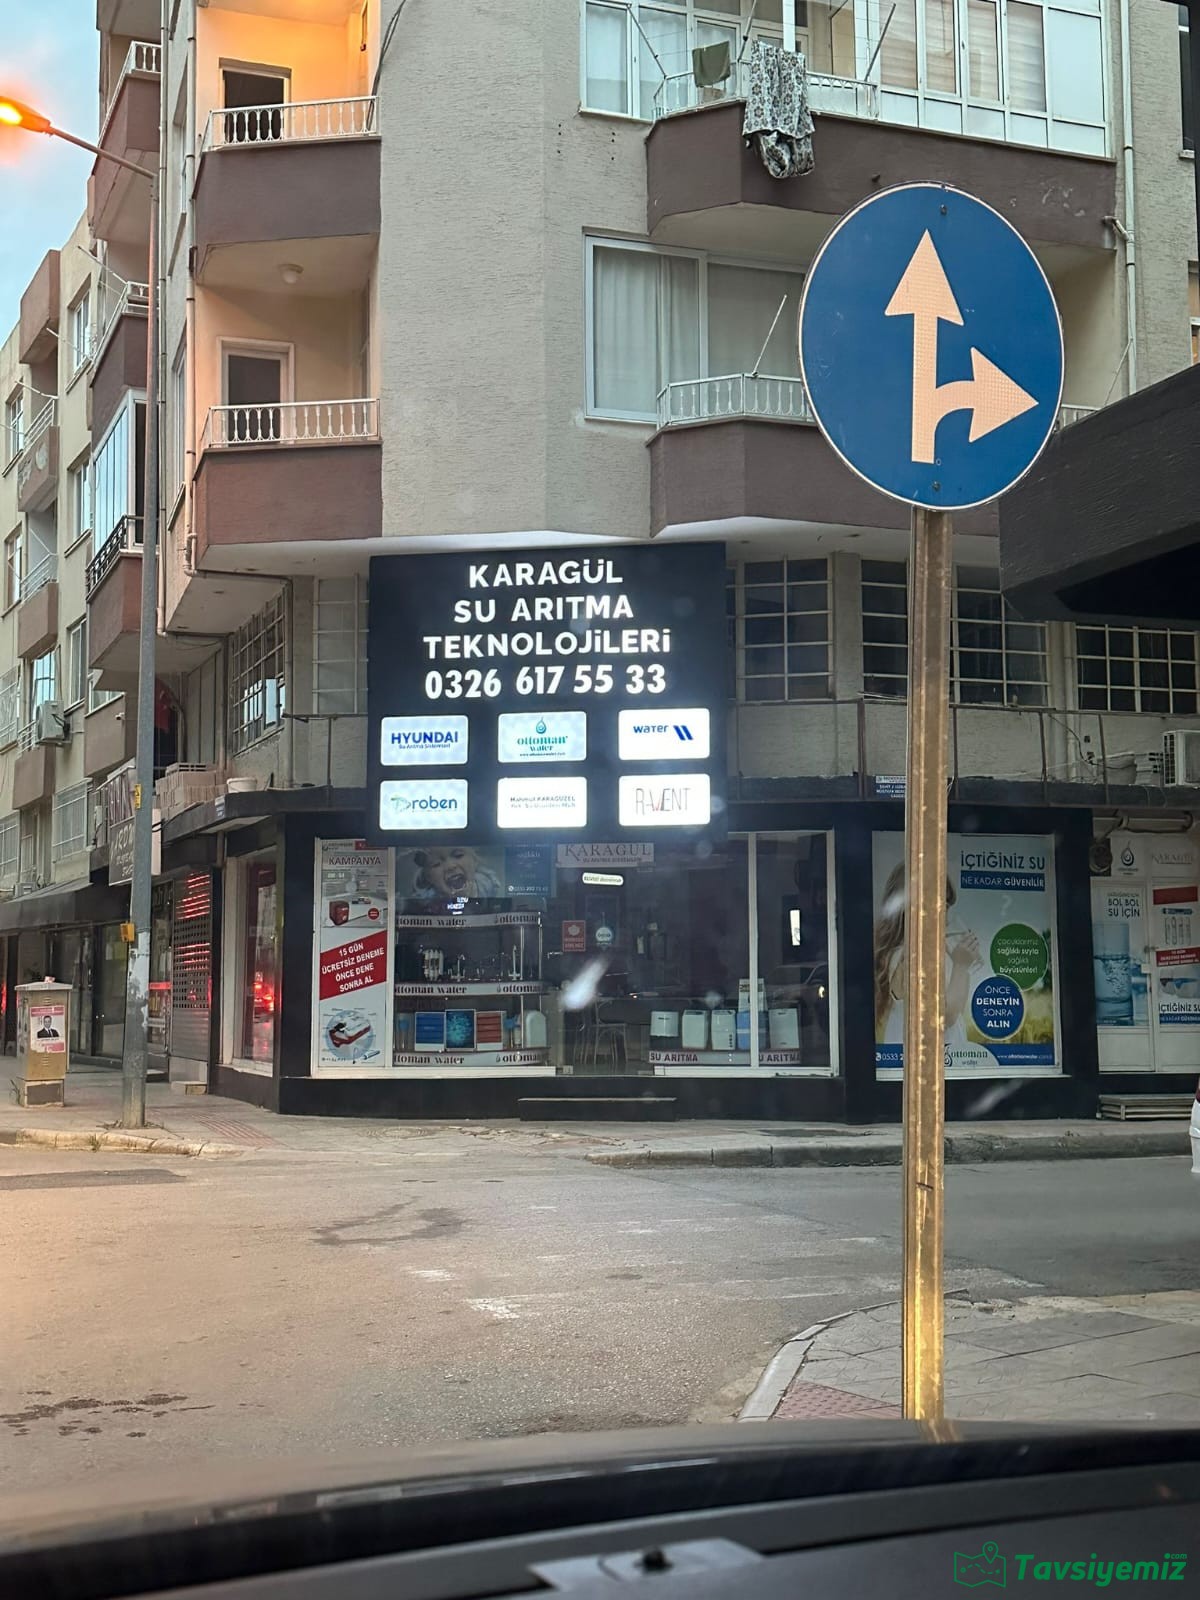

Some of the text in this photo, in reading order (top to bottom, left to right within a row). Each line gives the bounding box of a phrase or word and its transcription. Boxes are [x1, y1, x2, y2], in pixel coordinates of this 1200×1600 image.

[468, 558, 624, 588] KARAGÜL
[454, 594, 634, 624] SU ARITMA
[424, 664, 666, 700] 0326 617 55 33
[391, 731, 458, 744] HYUNDAI
[516, 736, 566, 745] ottoman
[329, 856, 381, 865] KAMPANYA
[961, 850, 1045, 870] İÇTİĞİNİZ SU
[962, 876, 973, 885] NE
[974, 877, 1001, 885] KADAR
[1108, 906, 1140, 918] SU İÇİN
[339, 942, 364, 956] 15 GÜN
[356, 948, 384, 963] DENEME
[356, 963, 374, 975] DENE
[340, 975, 373, 992] SONRA AL
[985, 985, 1011, 994] ÖNCE
[976, 997, 1020, 1005] DENEYİN
[983, 1008, 1013, 1016] SONRA
[435, 1055, 464, 1064] water
[650, 1052, 698, 1062] SU ARITMA
[951, 1050, 988, 1058] ottoman
